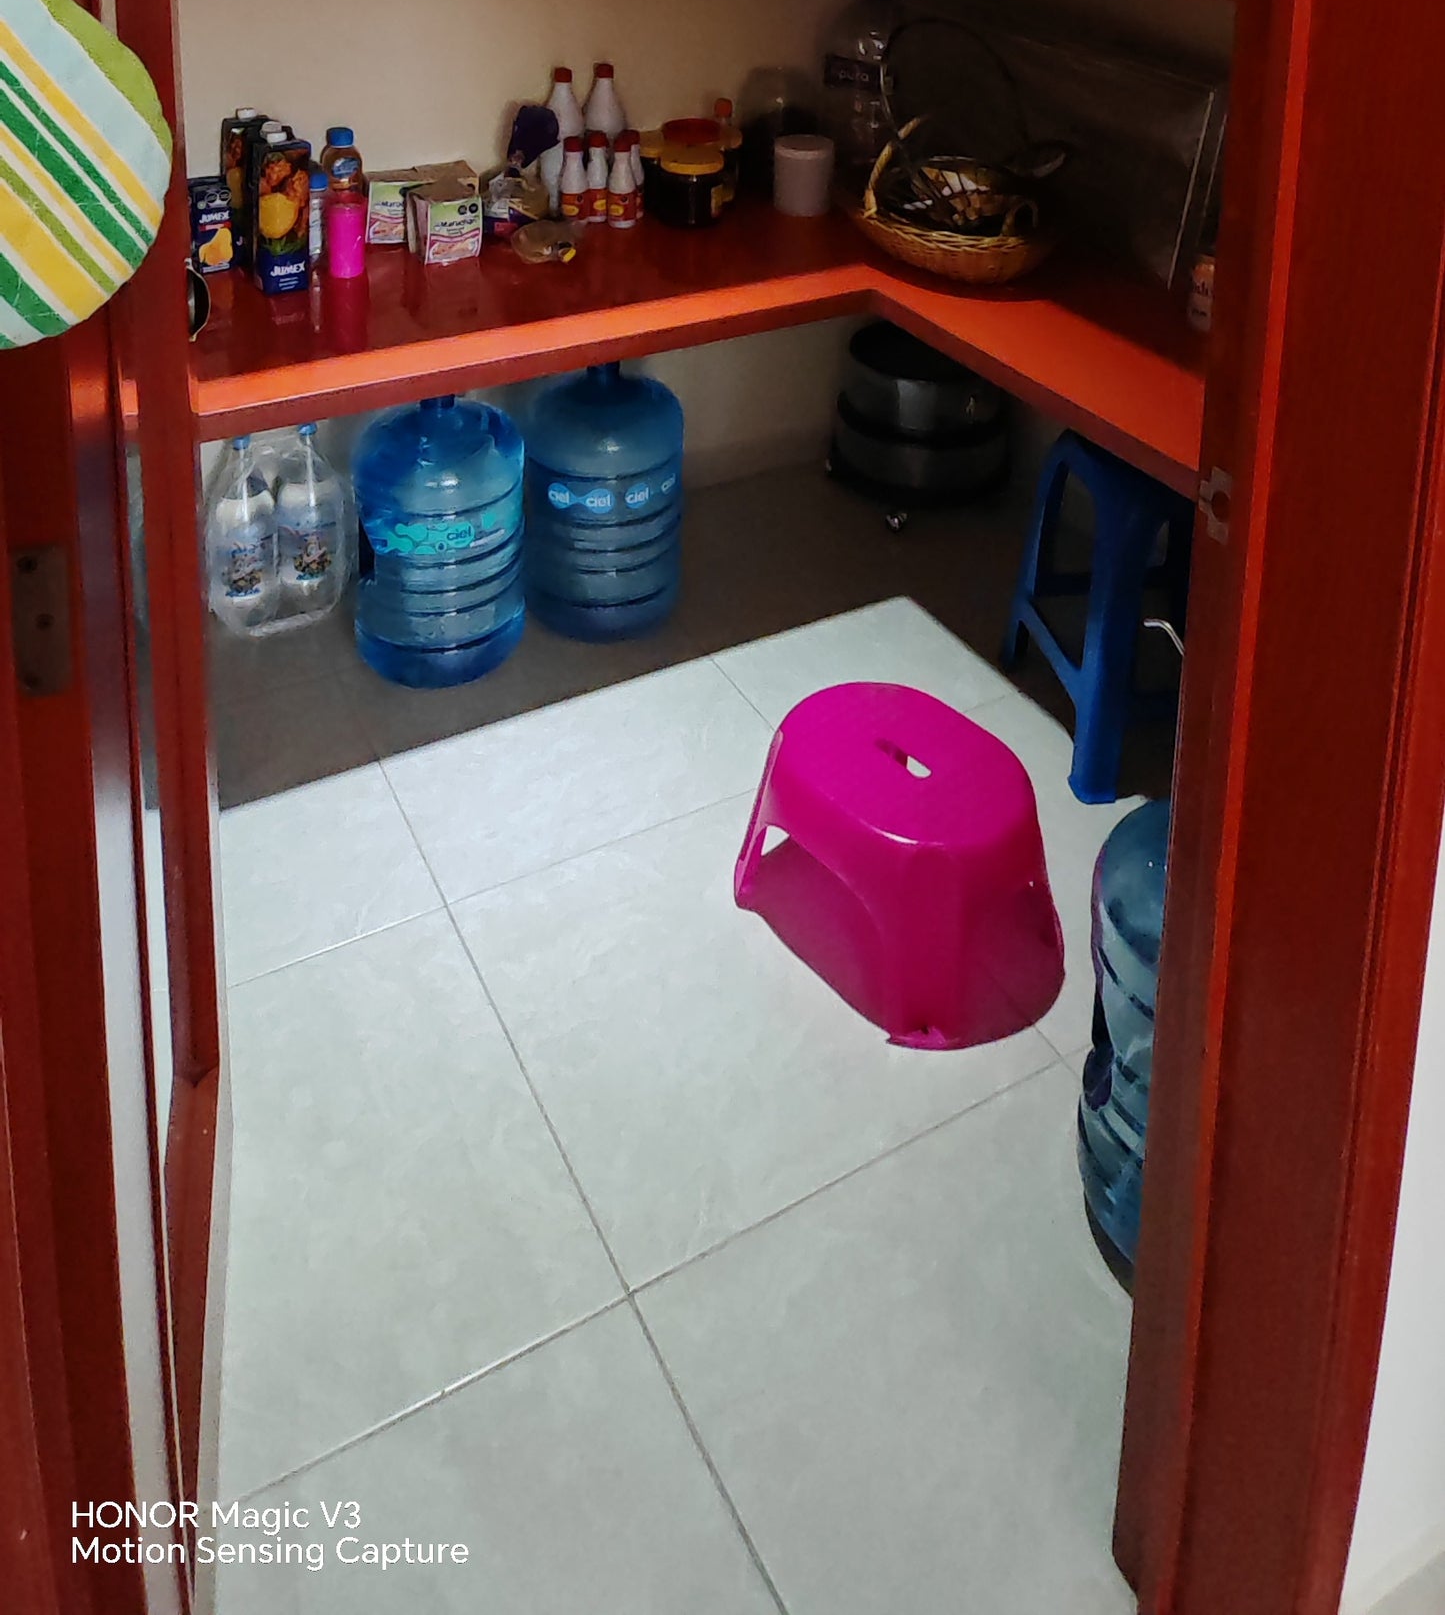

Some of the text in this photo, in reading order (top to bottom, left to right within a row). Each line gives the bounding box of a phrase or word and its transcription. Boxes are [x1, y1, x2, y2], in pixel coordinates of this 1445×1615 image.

[199, 210, 230, 224] JUMEX
[270, 261, 305, 277] JUMEX
[585, 494, 611, 507] ciel
[625, 487, 649, 504] ciel
[447, 526, 471, 541] ciel
